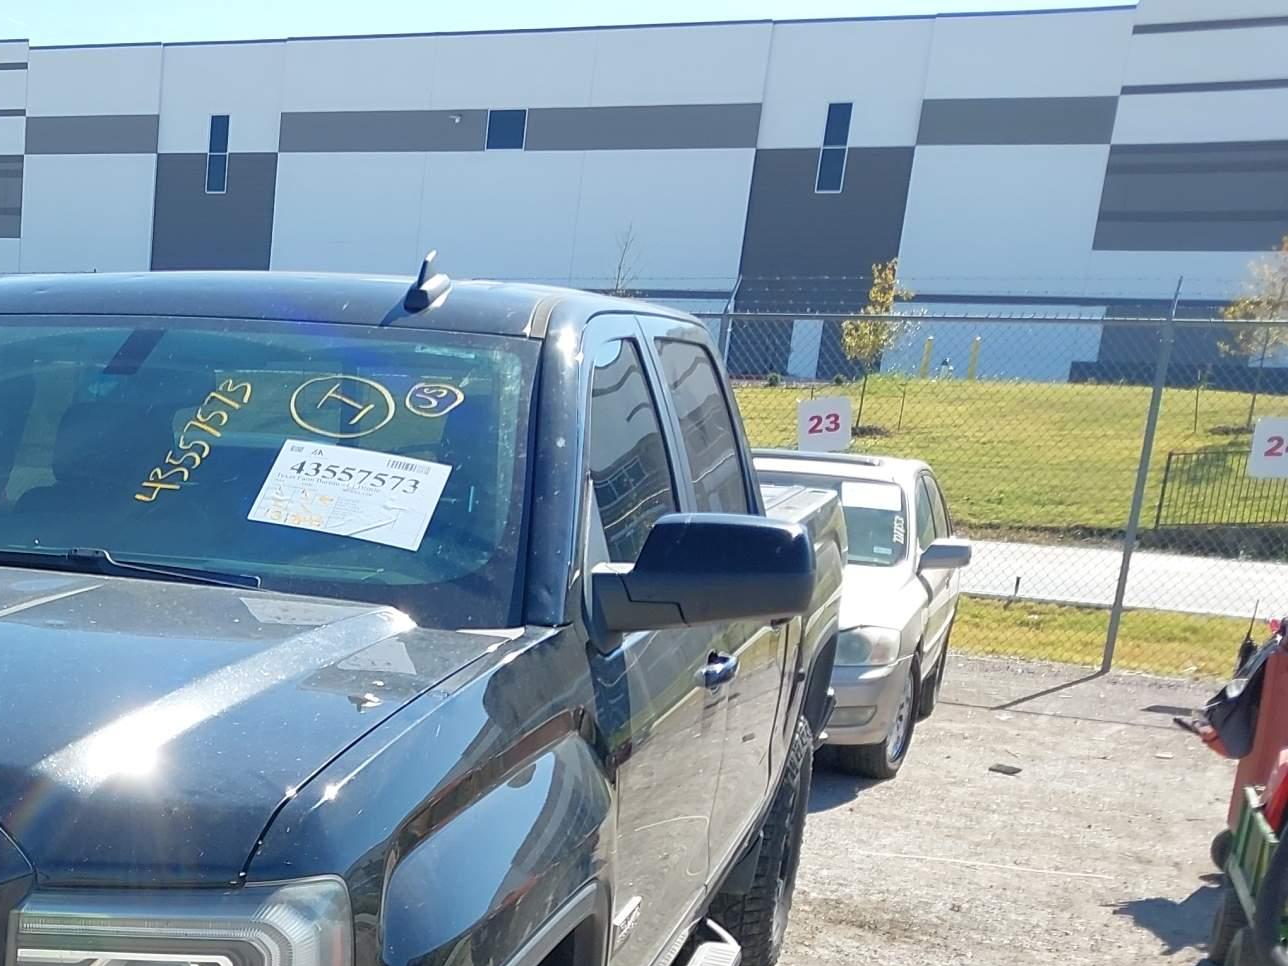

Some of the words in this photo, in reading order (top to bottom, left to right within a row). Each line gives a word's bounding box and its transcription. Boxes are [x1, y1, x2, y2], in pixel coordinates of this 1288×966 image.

[807, 413, 841, 435] 23
[134, 378, 252, 502] 43557573
[1263, 435, 1288, 457] 2
[289, 461, 421, 495] 43557573
